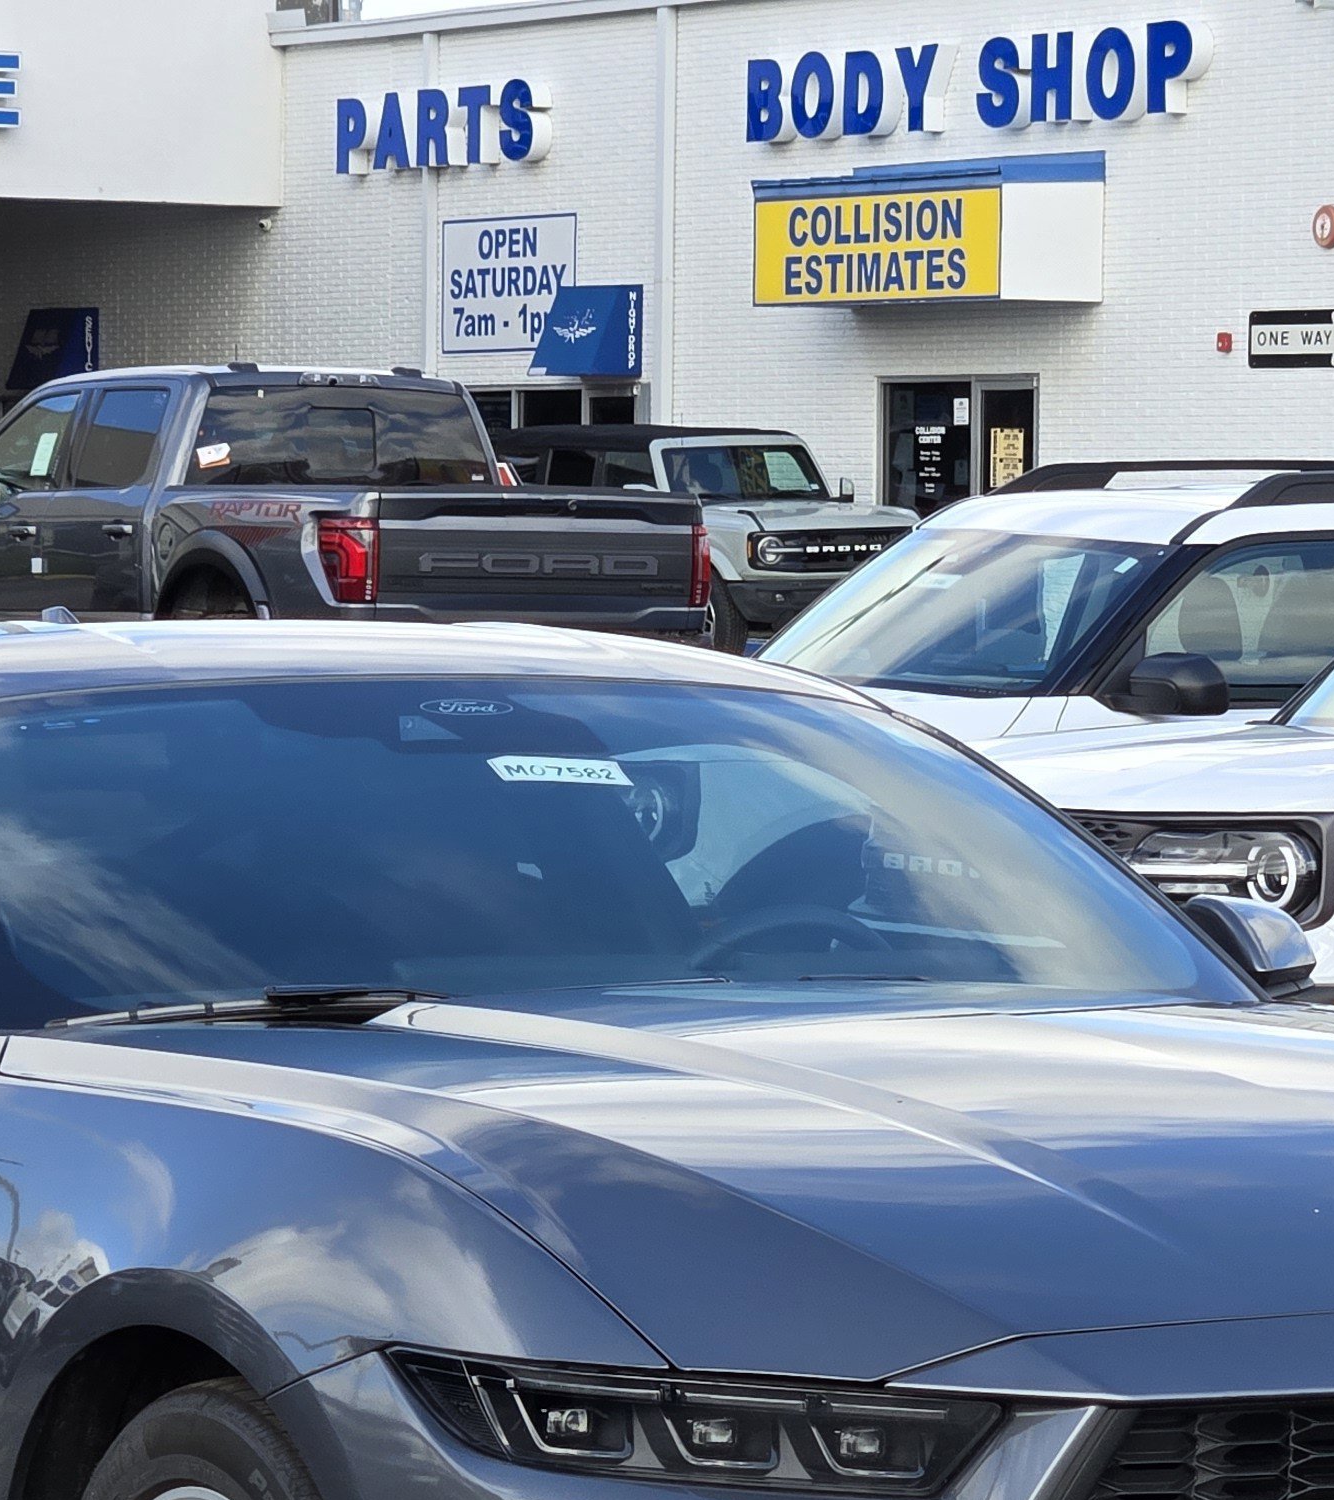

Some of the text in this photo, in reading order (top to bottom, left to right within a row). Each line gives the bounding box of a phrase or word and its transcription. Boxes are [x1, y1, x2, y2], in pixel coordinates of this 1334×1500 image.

[746, 20, 1193, 142] BODY SHOP
[336, 79, 535, 174] PARTS
[789, 198, 963, 246] COLLISION
[478, 226, 537, 260] OPEN
[450, 264, 567, 300] SATURDAY
[785, 248, 966, 295] ESTIMATES
[453, 306, 496, 338] 7am
[518, 303, 548, 342] 1p
[1257, 330, 1332, 346] ONE WAY
[85, 315, 93, 371] SERVIC
[208, 500, 302, 523] RAPTOR
[418, 553, 659, 576] FORD
[806, 544, 882, 553] BRONC
[438, 701, 498, 713] Ford
[883, 852, 981, 878] BRO
